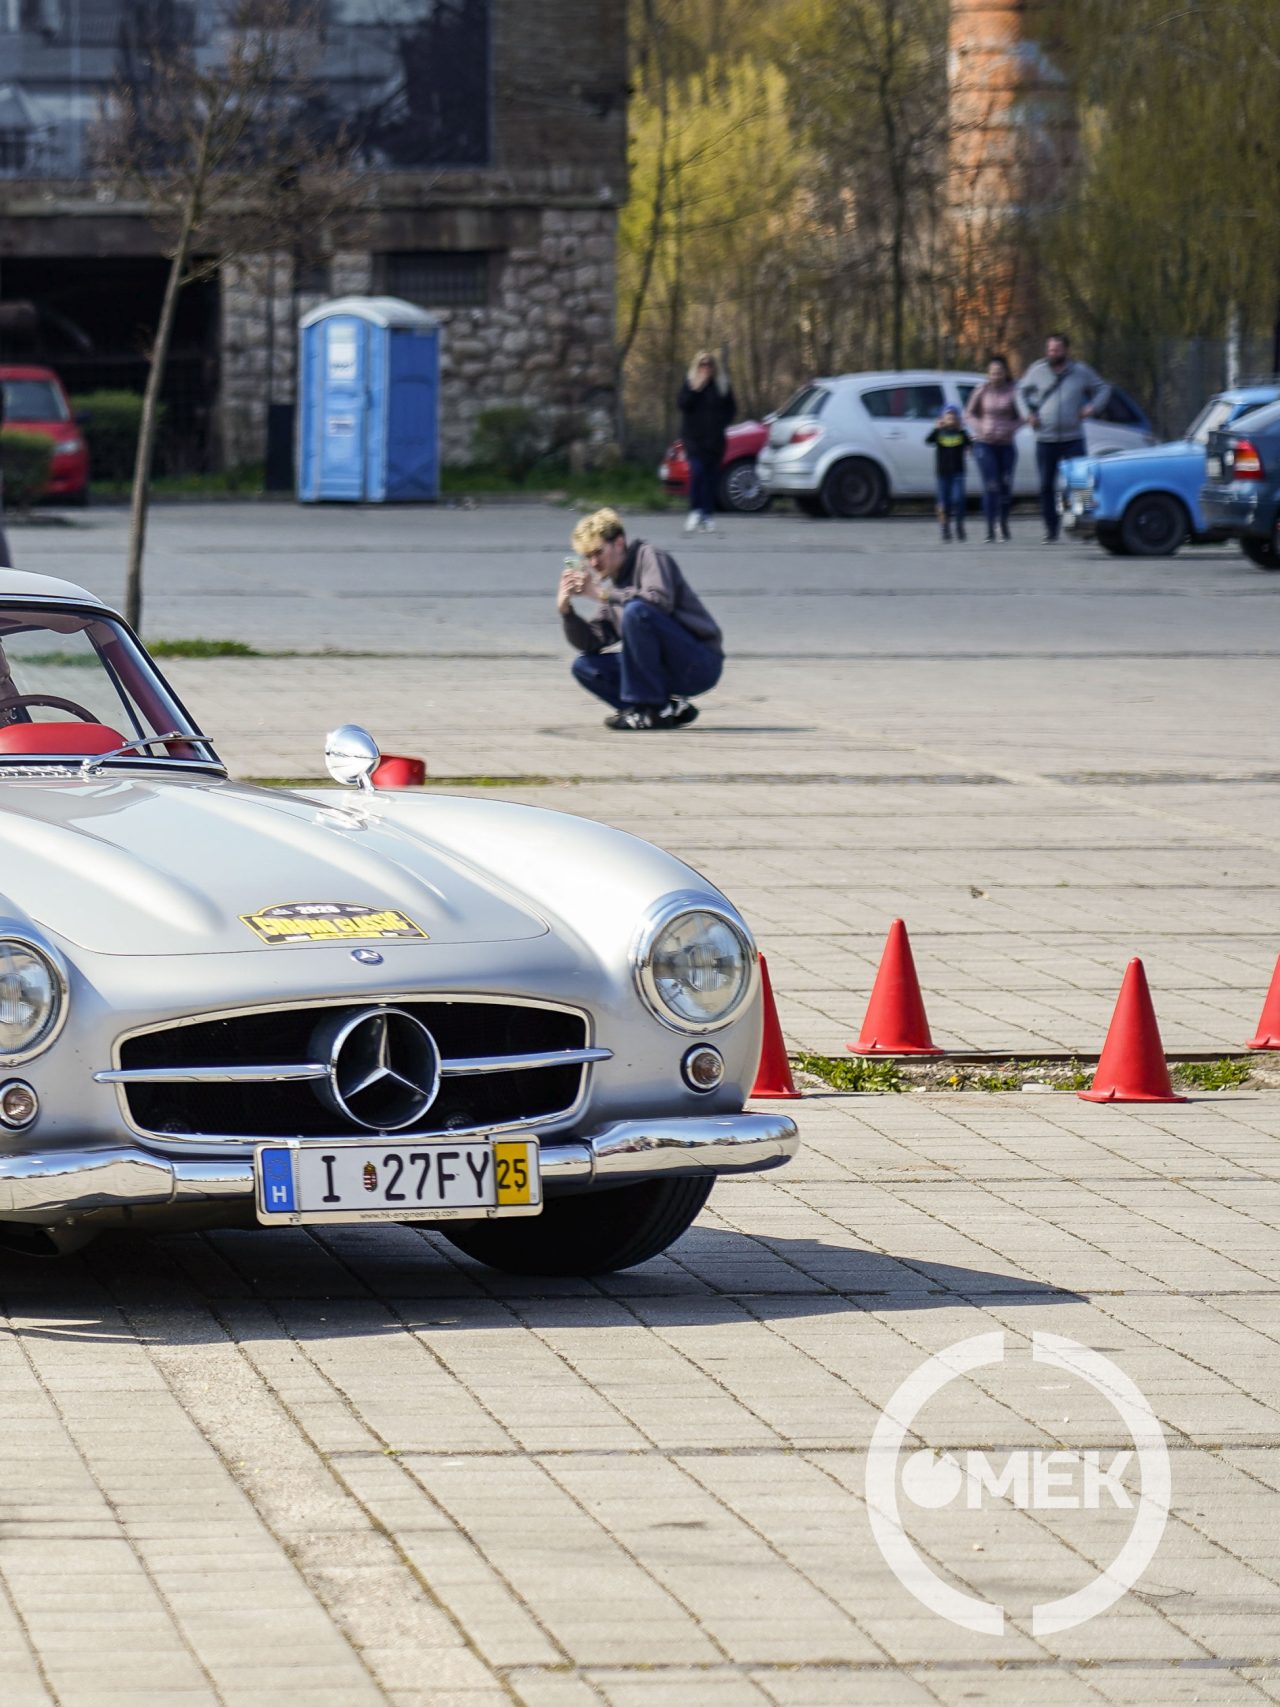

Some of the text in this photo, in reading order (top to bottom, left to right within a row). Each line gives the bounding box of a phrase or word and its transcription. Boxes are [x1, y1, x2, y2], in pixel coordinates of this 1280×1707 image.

[334, 912, 410, 932] CLASSIC
[272, 1151, 527, 1203] H I 27FY 25
[360, 1209, 459, 1221] www.hk-engineering.com
